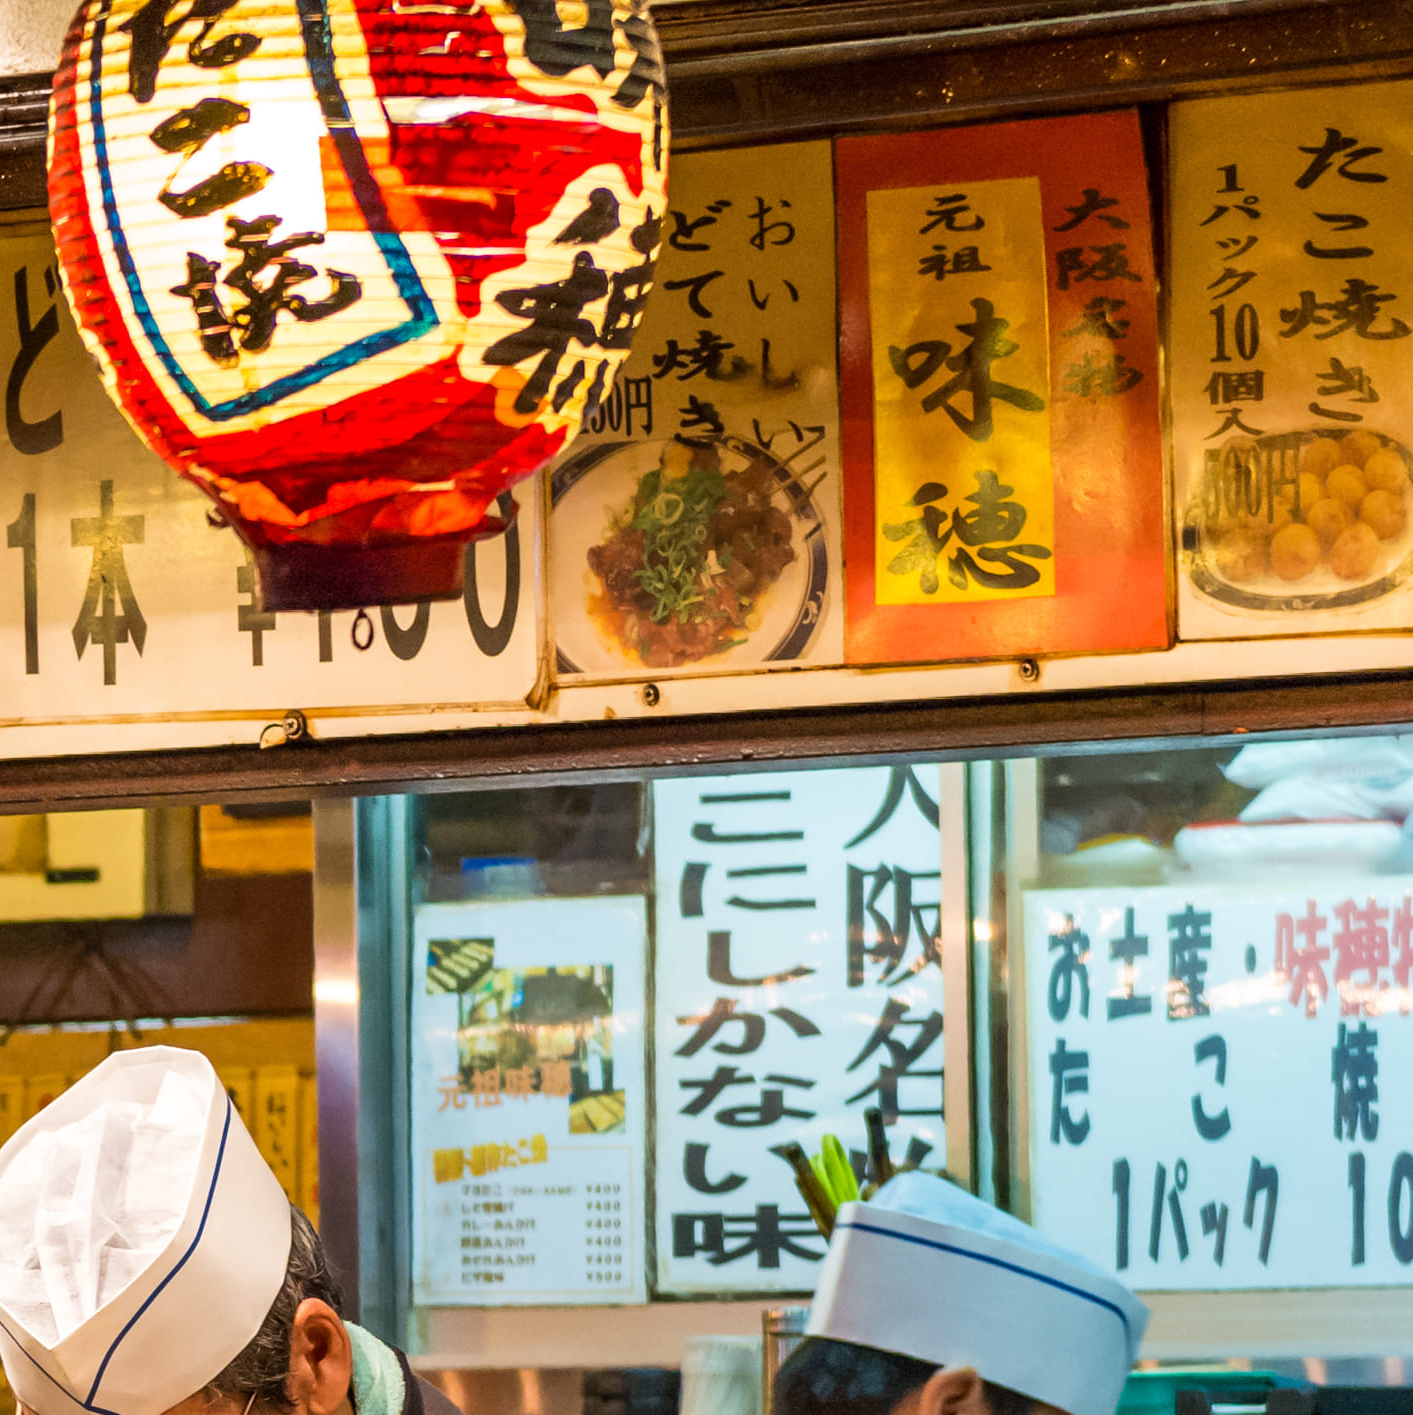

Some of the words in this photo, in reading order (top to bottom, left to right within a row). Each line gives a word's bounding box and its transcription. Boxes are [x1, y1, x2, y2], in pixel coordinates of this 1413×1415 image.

[652, 199, 753, 450] どて焼き
[747, 196, 801, 452] おいしい
[1199, 163, 1266, 442] 1パック10個入
[1279, 127, 1412, 424] たこ焼き
[888, 296, 1053, 595] 味穂
[6, 479, 147, 686] 1本
[1048, 1020, 1380, 1146] たこ焼
[1111, 1154, 1280, 1272] 1パック
